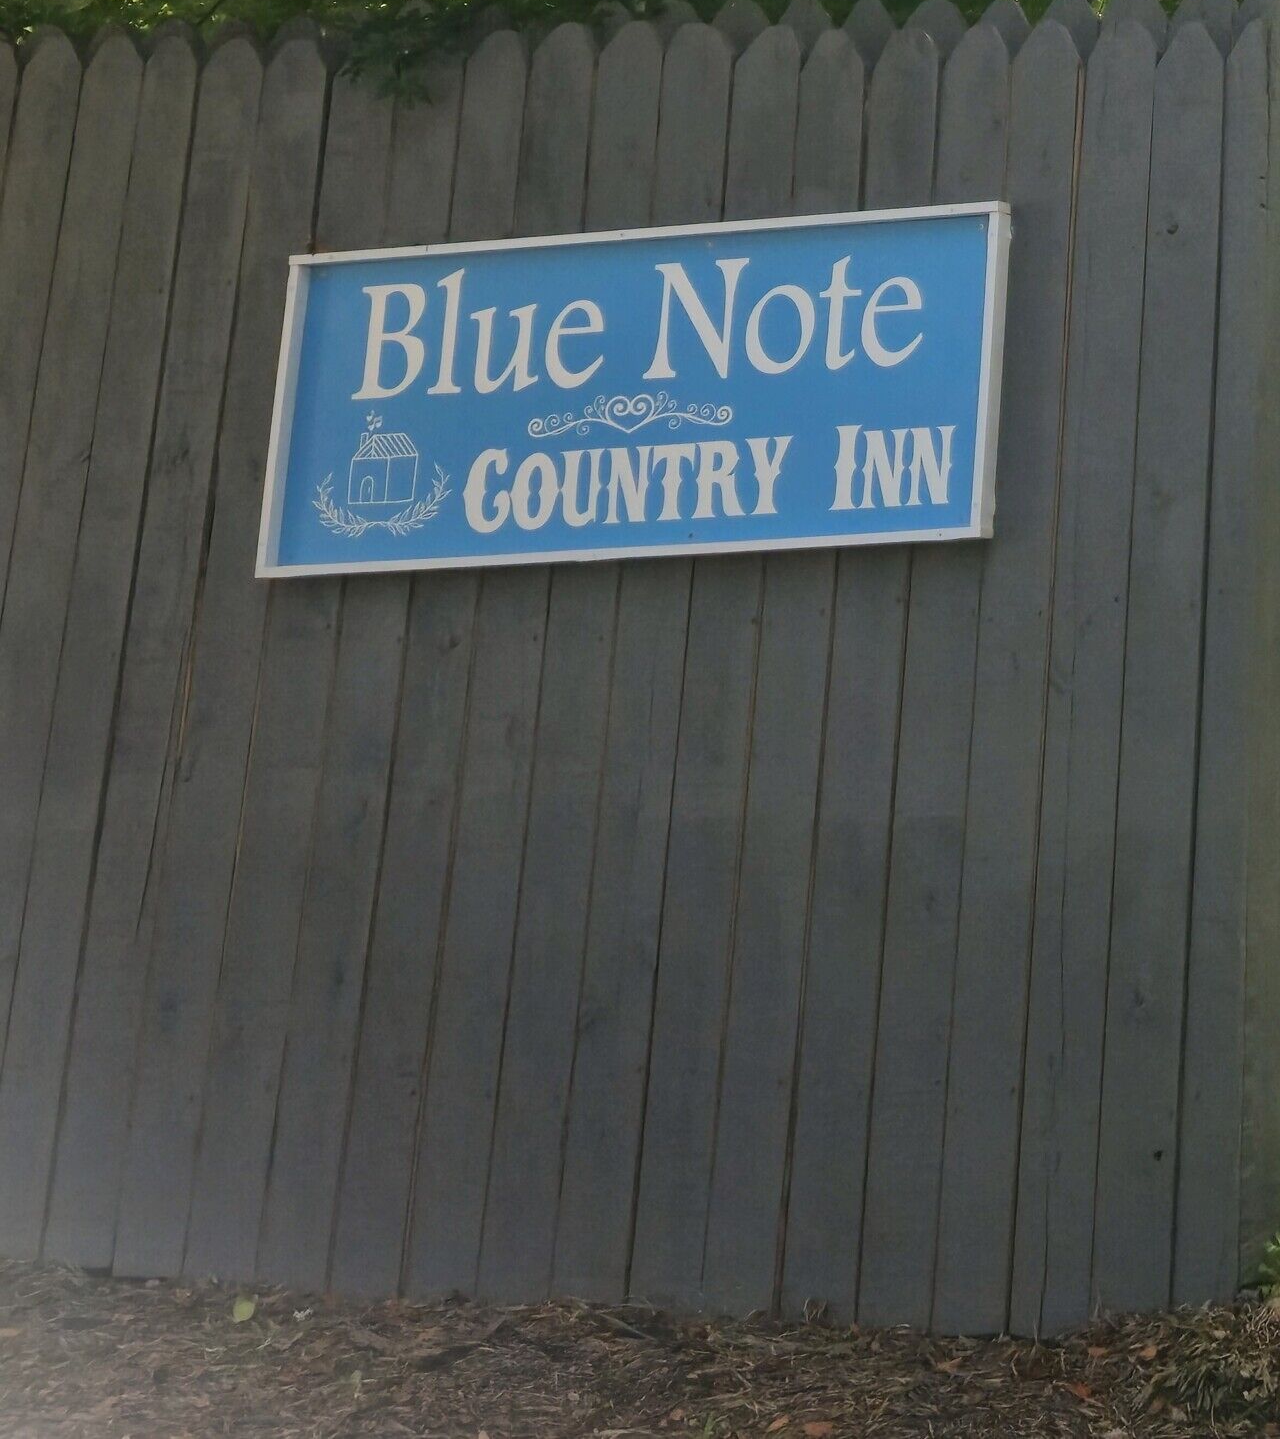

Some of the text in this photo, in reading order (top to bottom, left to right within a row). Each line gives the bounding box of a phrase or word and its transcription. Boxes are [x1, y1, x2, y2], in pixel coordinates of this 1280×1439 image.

[351, 255, 924, 400] Blue Note
[463, 424, 957, 534] COUNTRY INN
